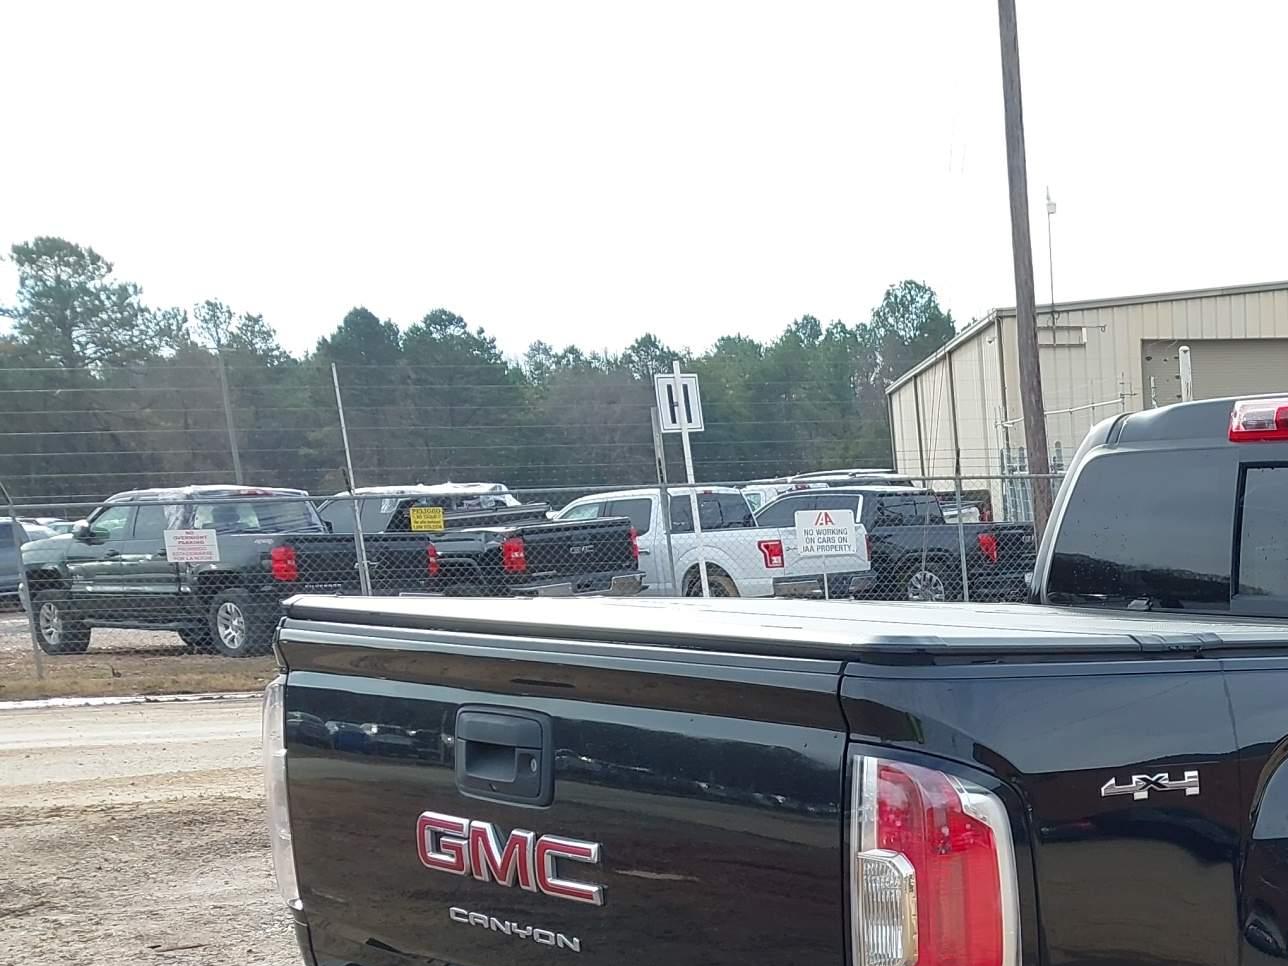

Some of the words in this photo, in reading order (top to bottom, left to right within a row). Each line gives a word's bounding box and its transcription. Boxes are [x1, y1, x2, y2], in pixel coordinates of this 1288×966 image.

[803, 528, 814, 536] NO
[816, 528, 848, 536] WORKING
[416, 811, 606, 906] GMC
[449, 906, 582, 953] CANYON
